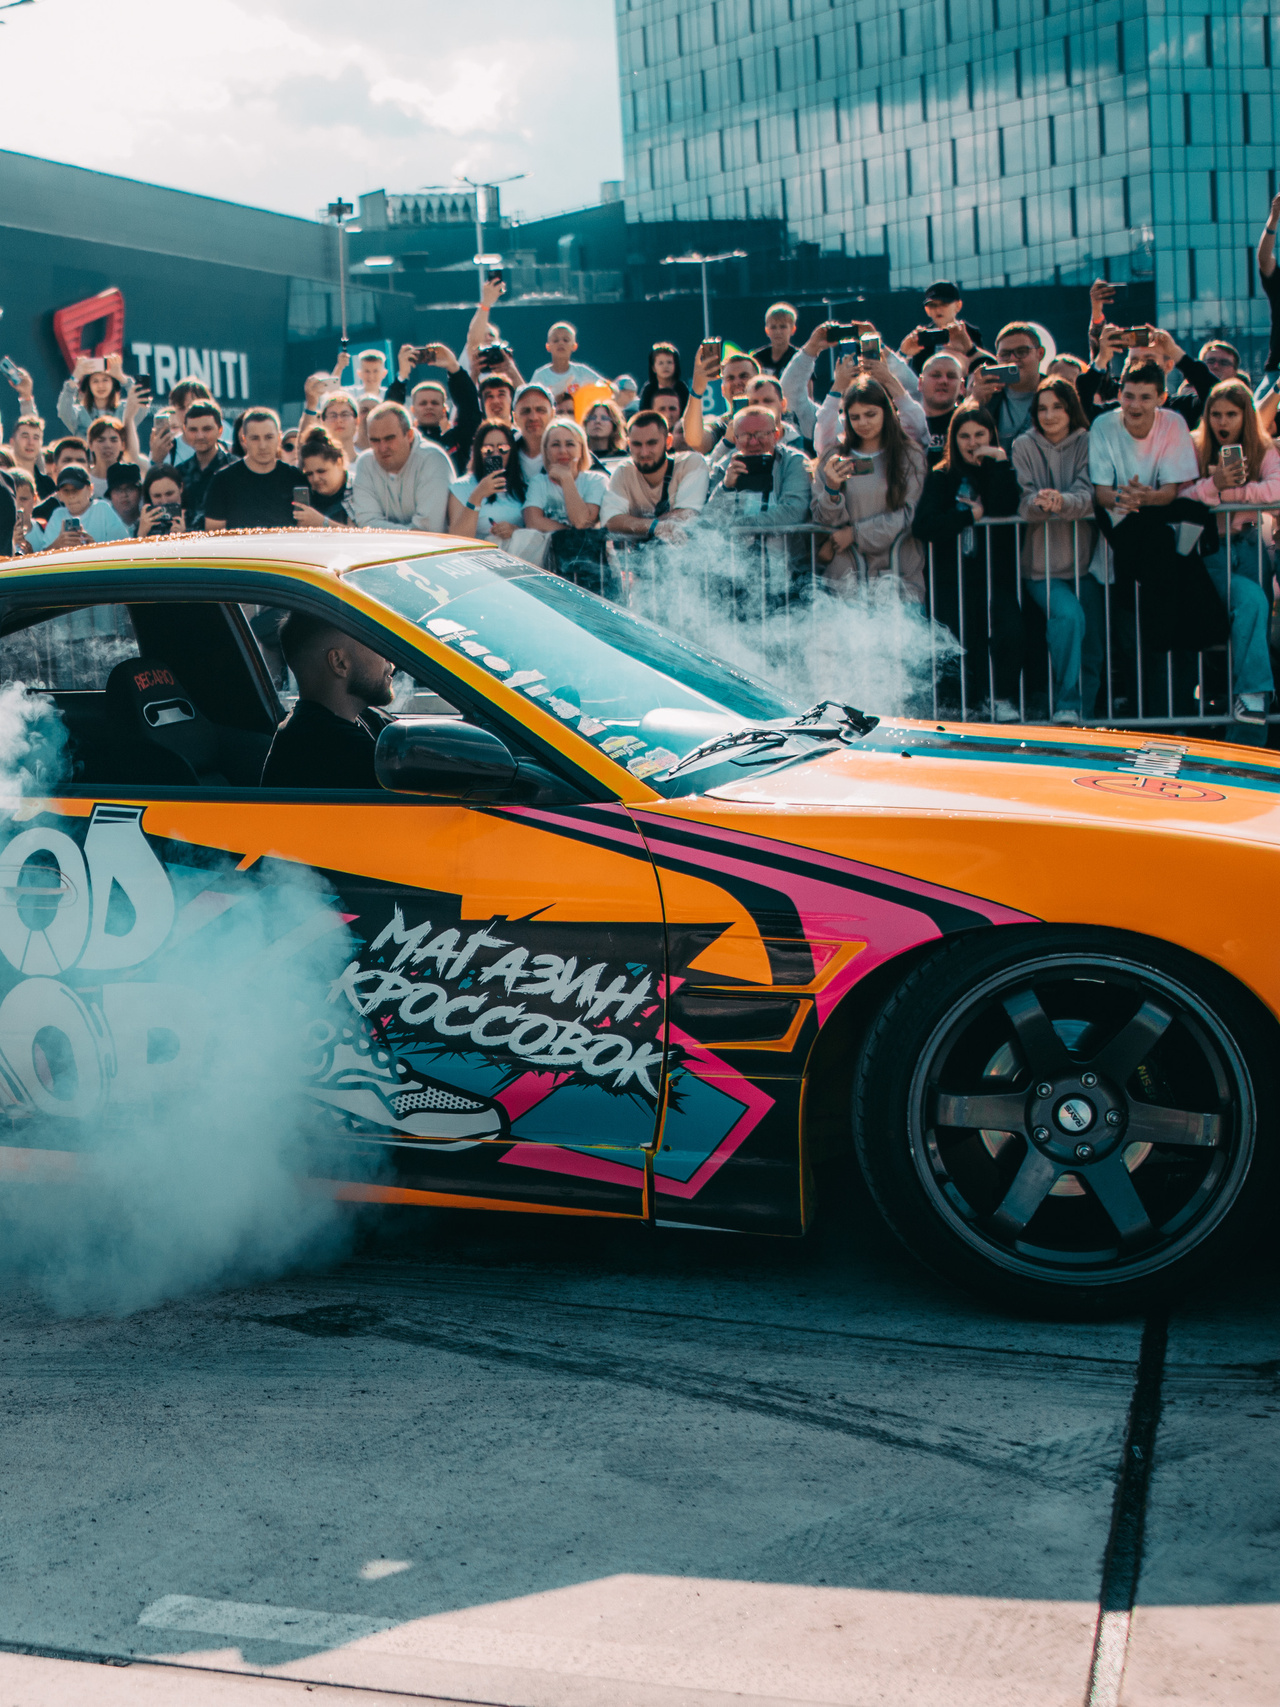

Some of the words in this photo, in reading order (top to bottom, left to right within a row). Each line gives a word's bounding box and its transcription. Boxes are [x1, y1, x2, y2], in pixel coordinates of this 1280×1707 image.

[131, 342, 249, 399] TRINITI
[133, 669, 175, 692] RECARO
[369, 902, 653, 1021] МАГАЗИН
[325, 960, 683, 1100] КРОССОВОК
[1063, 1104, 1084, 1128] RAYS
